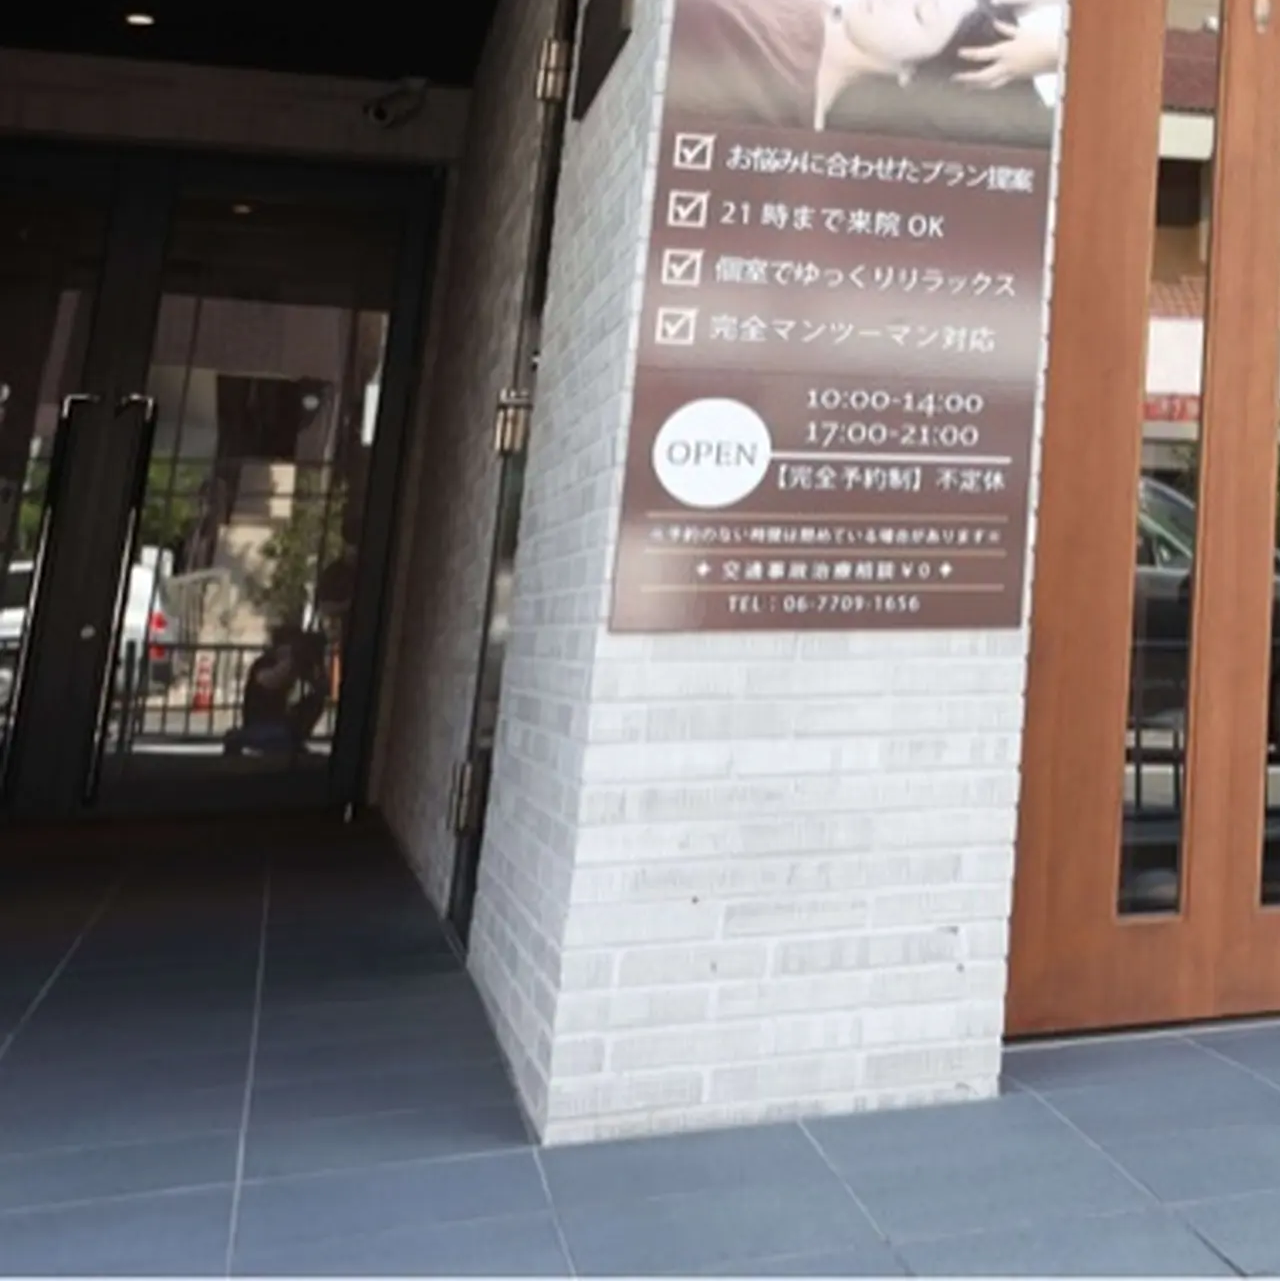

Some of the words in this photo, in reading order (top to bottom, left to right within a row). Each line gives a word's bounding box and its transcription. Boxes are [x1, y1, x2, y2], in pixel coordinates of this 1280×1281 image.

[715, 255, 1016, 297] 個室でゆっくりリラックス
[709, 315, 996, 352] 完全マンツーマン対応
[806, 389, 984, 417] 10:00-14:00
[806, 422, 980, 447] 17:00-21:00
[667, 440, 758, 467] OPEN
[936, 469, 1006, 493] 不定休
